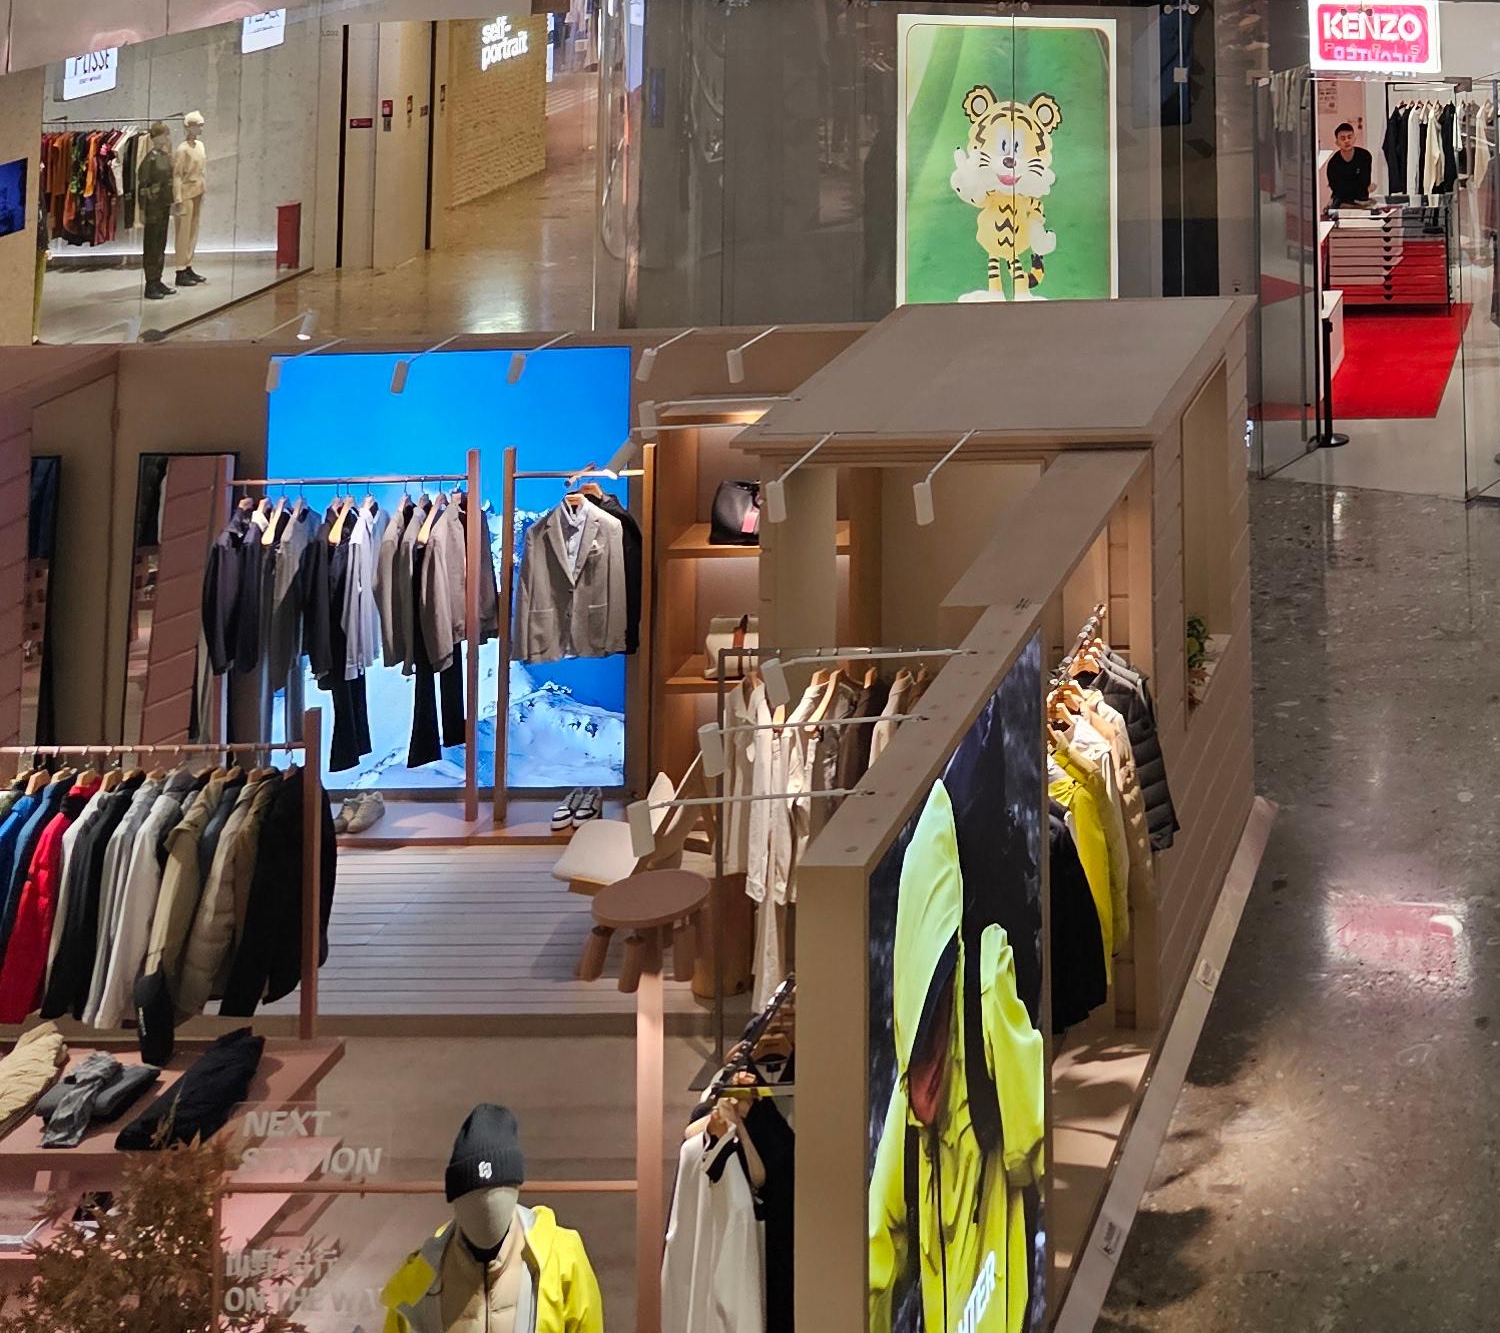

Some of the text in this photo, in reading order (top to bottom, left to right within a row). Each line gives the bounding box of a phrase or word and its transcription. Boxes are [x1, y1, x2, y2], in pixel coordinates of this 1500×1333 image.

[482, 15, 512, 44] self-
[1323, 12, 1422, 42] KENZO
[481, 31, 528, 72] portrait
[244, 1110, 332, 1137] NEXT
[224, 1286, 265, 1312] ON
